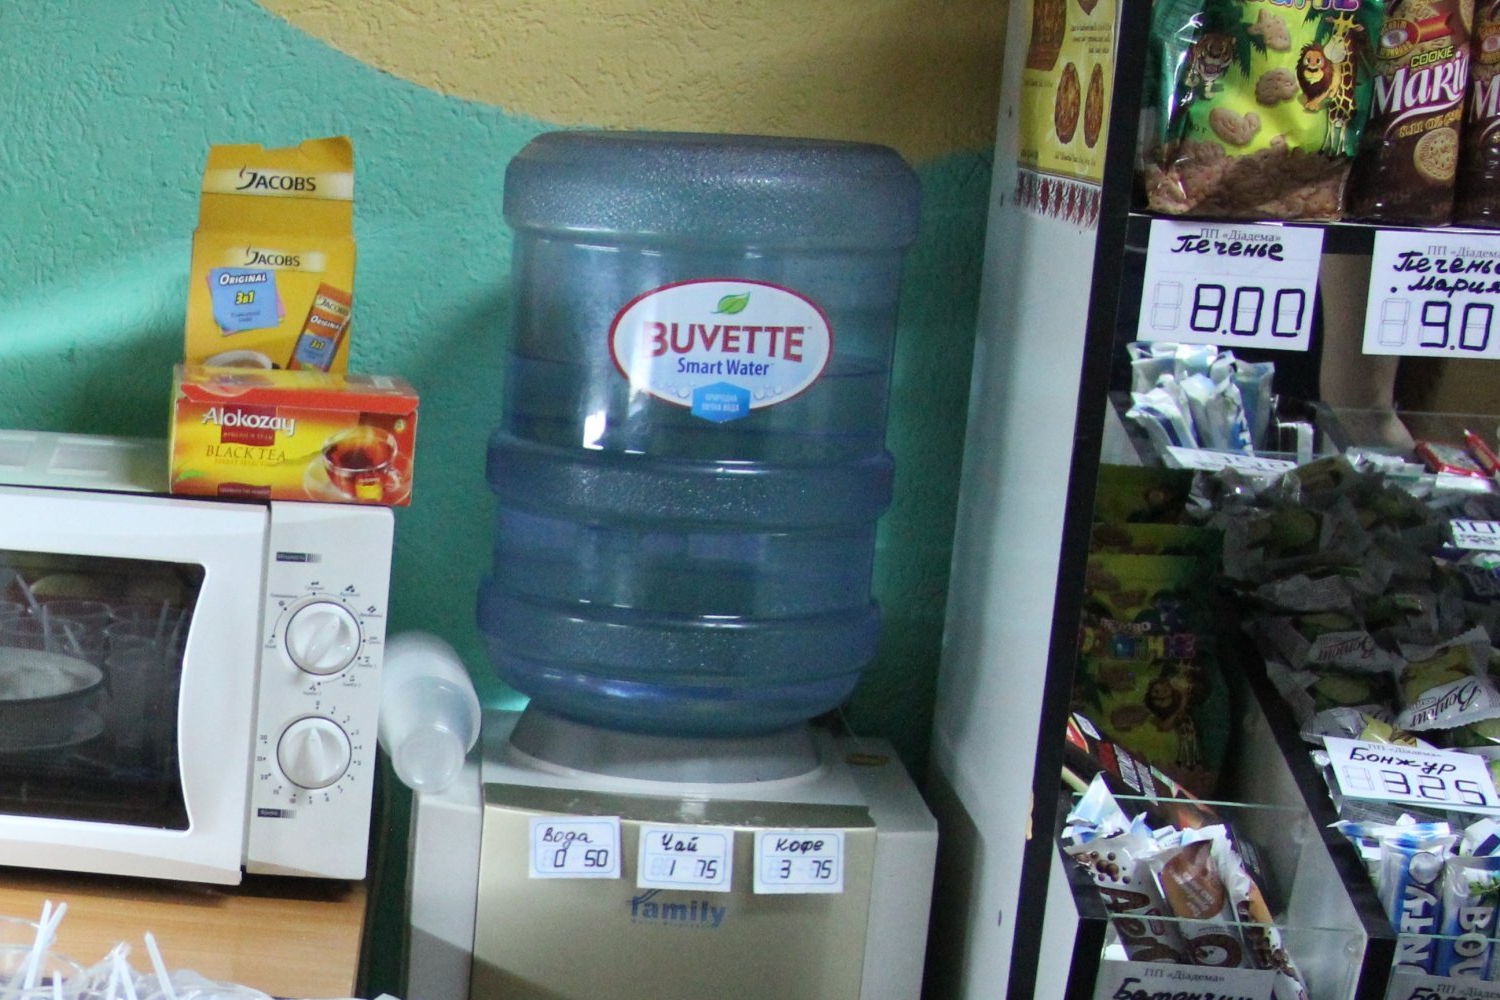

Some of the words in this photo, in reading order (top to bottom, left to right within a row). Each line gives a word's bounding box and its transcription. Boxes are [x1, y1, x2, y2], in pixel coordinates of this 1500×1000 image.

[1410, 45, 1454, 68] COOKIE
[236, 164, 317, 192] JACOBS
[243, 243, 301, 268] JACOBS
[1171, 233, 1284, 263] Печенье
[1190, 283, 1306, 338] 8.00
[1420, 301, 1500, 351] 9.0
[642, 321, 805, 363] BUVETTE
[677, 357, 723, 375] Smart
[726, 359, 770, 376] Water
[202, 406, 296, 437] Alokozay
[206, 445, 253, 459] BLACK
[258, 447, 286, 462] TEA
[1349, 746, 1457, 775] Бонжур
[542, 826, 594, 851] Вода
[661, 833, 698, 852] Чай
